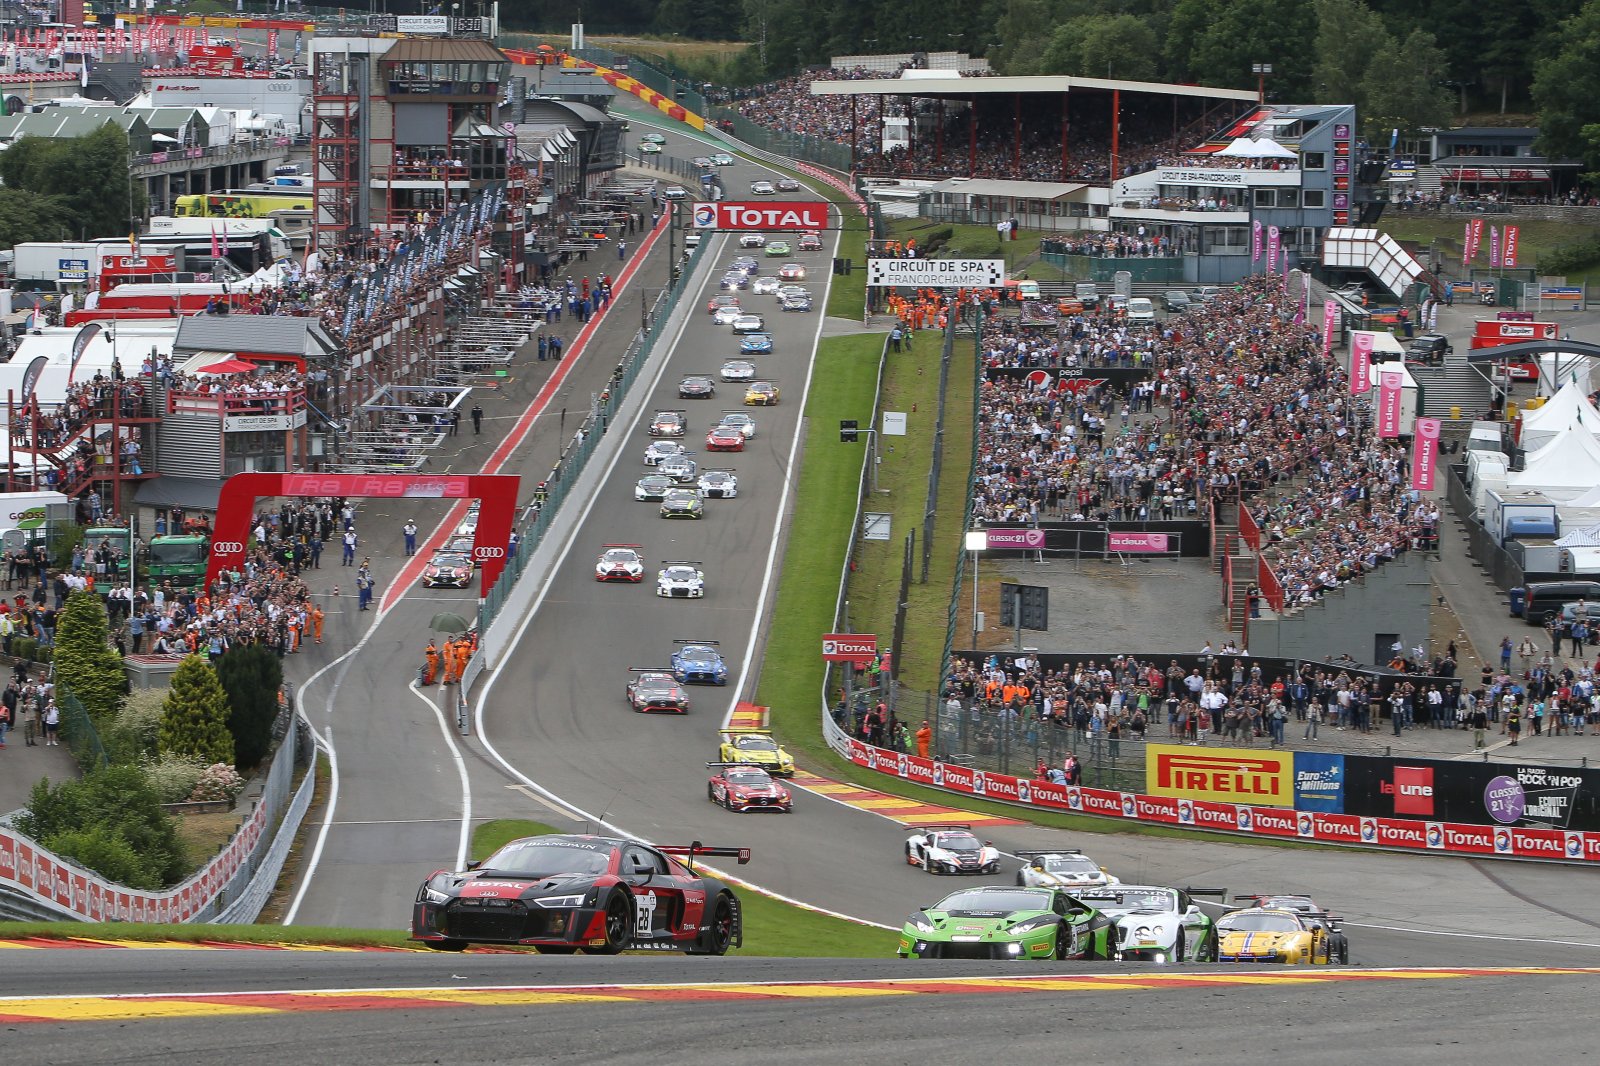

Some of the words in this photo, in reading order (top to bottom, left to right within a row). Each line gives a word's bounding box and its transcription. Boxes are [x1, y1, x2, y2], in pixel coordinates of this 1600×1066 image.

[453, 17, 481, 31] 16:30
[723, 206, 819, 226] TOTAL
[1506, 227, 1516, 256] TOTAL
[889, 262, 935, 271] CIRCUIT
[943, 262, 955, 272] DE
[961, 262, 984, 272] SPA
[888, 275, 982, 284] FRANCORCHAMPS
[24, 372, 35, 396] WRT
[1357, 380, 1364, 390] la
[1386, 391, 1395, 420] deux
[1384, 422, 1393, 432] la
[1421, 440, 1430, 472] deux
[1419, 474, 1428, 485] la
[837, 644, 876, 652] TOTAL
[875, 754, 897, 769] TOTAL
[907, 762, 932, 778] TOTAL
[944, 769, 972, 787] TOTAL
[1158, 754, 1280, 795] PIRELLI
[1298, 771, 1320, 781] Euro
[986, 778, 1017, 796] TOTAL
[1301, 781, 1340, 790] Millions
[1380, 780, 1394, 794] la
[1400, 784, 1433, 796] une
[1518, 774, 1547, 785] ROCK
[1560, 777, 1582, 788] POP
[1032, 786, 1067, 802] TOTAL
[1490, 787, 1521, 798] CLASSIC
[1082, 794, 1120, 810] TOTAL
[1136, 801, 1177, 817] TOTAL
[1492, 800, 1505, 811] 21
[1539, 797, 1568, 806] ECOUTEZ
[1194, 807, 1235, 824] TOTAL
[1524, 805, 1562, 818] L'ORIGINAL
[1254, 812, 1296, 830] TOTAL
[1315, 818, 1359, 836] TOTAL
[1379, 824, 1424, 842] TOTAL
[1445, 830, 1492, 847] TOTAL
[527, 842, 597, 850] BLANCPAIN
[1514, 834, 1563, 851] TOTAL
[638, 908, 649, 930] 28
